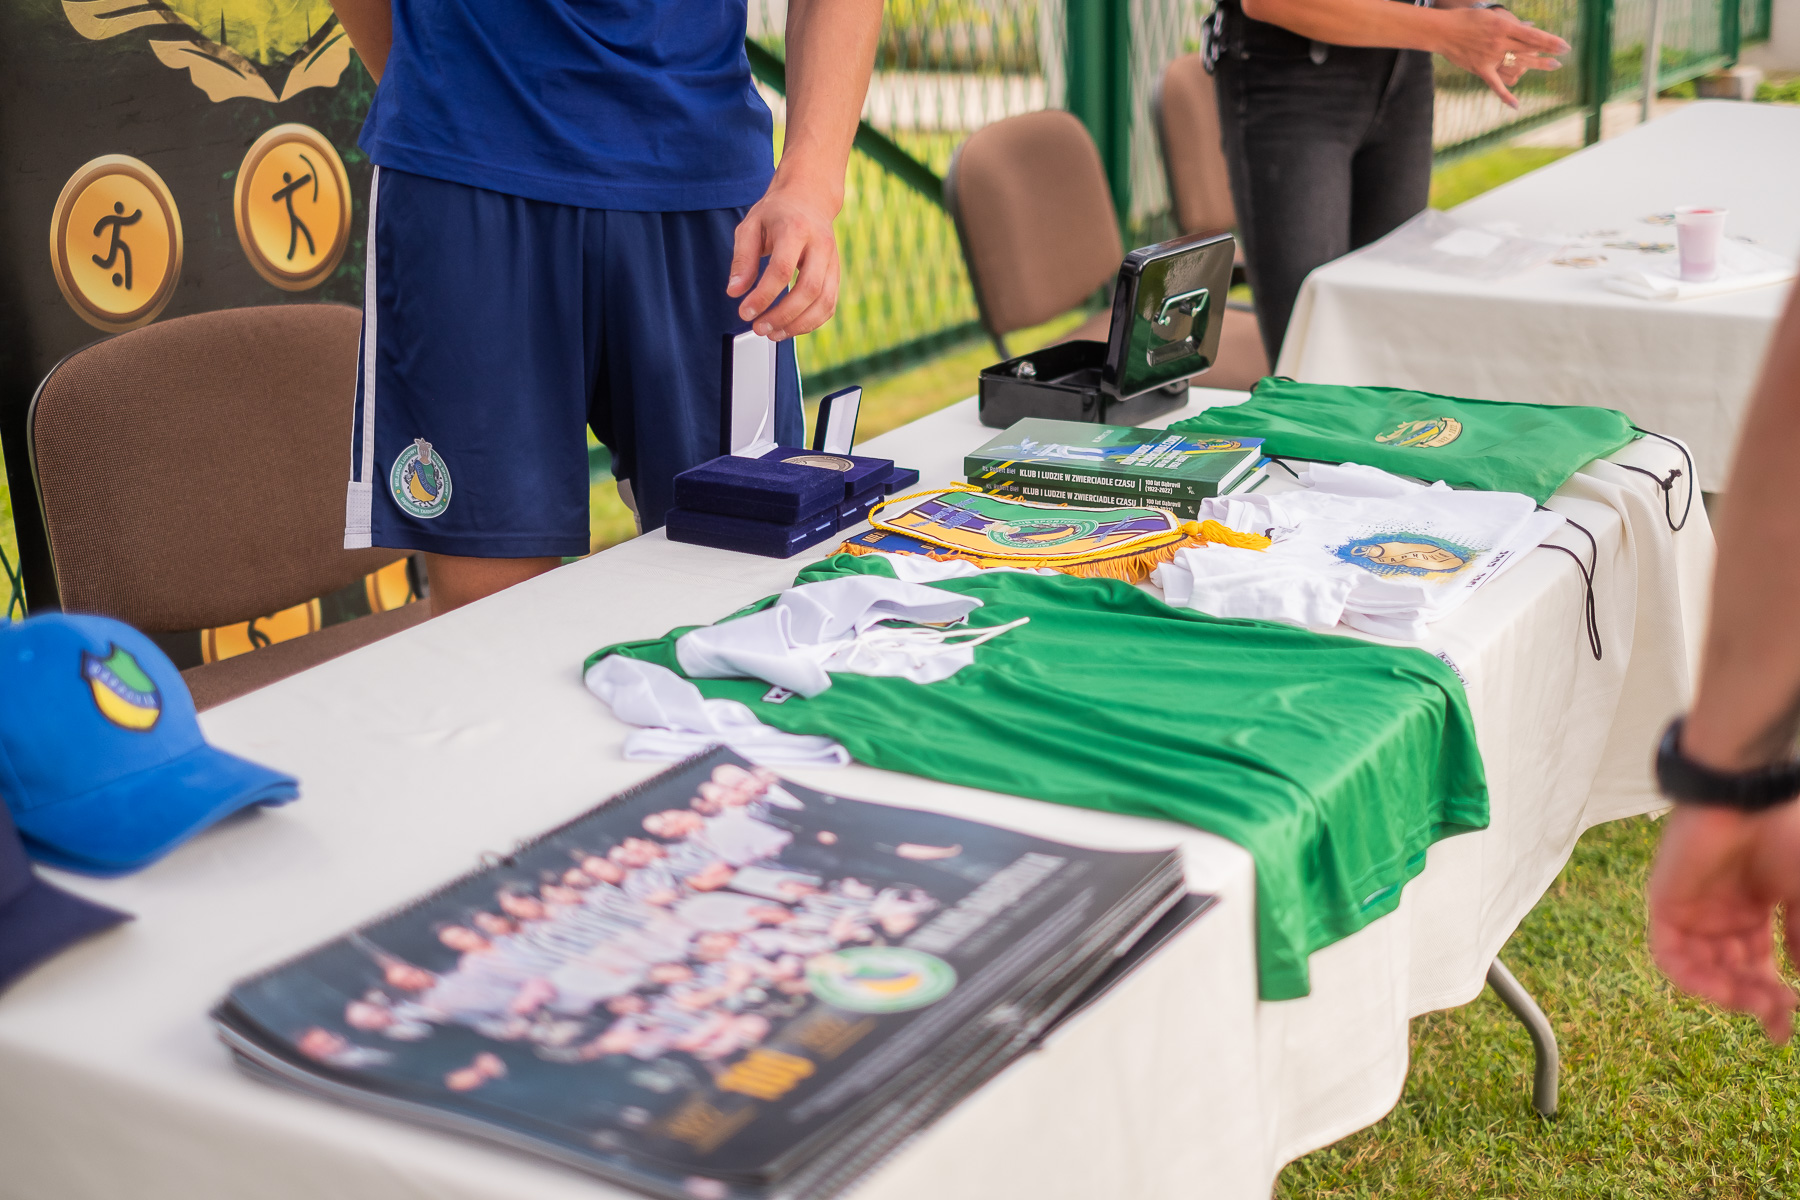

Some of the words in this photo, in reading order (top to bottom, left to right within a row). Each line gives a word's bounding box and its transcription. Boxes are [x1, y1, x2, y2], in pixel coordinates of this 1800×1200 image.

[990, 466, 1006, 474] Robert
[1019, 468, 1037, 478] KLUB
[1041, 471, 1064, 481] LUDZIE
[1064, 473, 1071, 482] W
[1071, 474, 1114, 487] ZWIERCIADLE
[1114, 478, 1136, 489] CZASU
[1022, 486, 1040, 496] KLUB
[1043, 488, 1066, 499] LUDZIE
[1066, 491, 1074, 500] W
[1073, 492, 1115, 505] ZWIERCIADLE
[1115, 497, 1137, 507] CZASU
[1144, 485, 1173, 495] (1922-2022)
